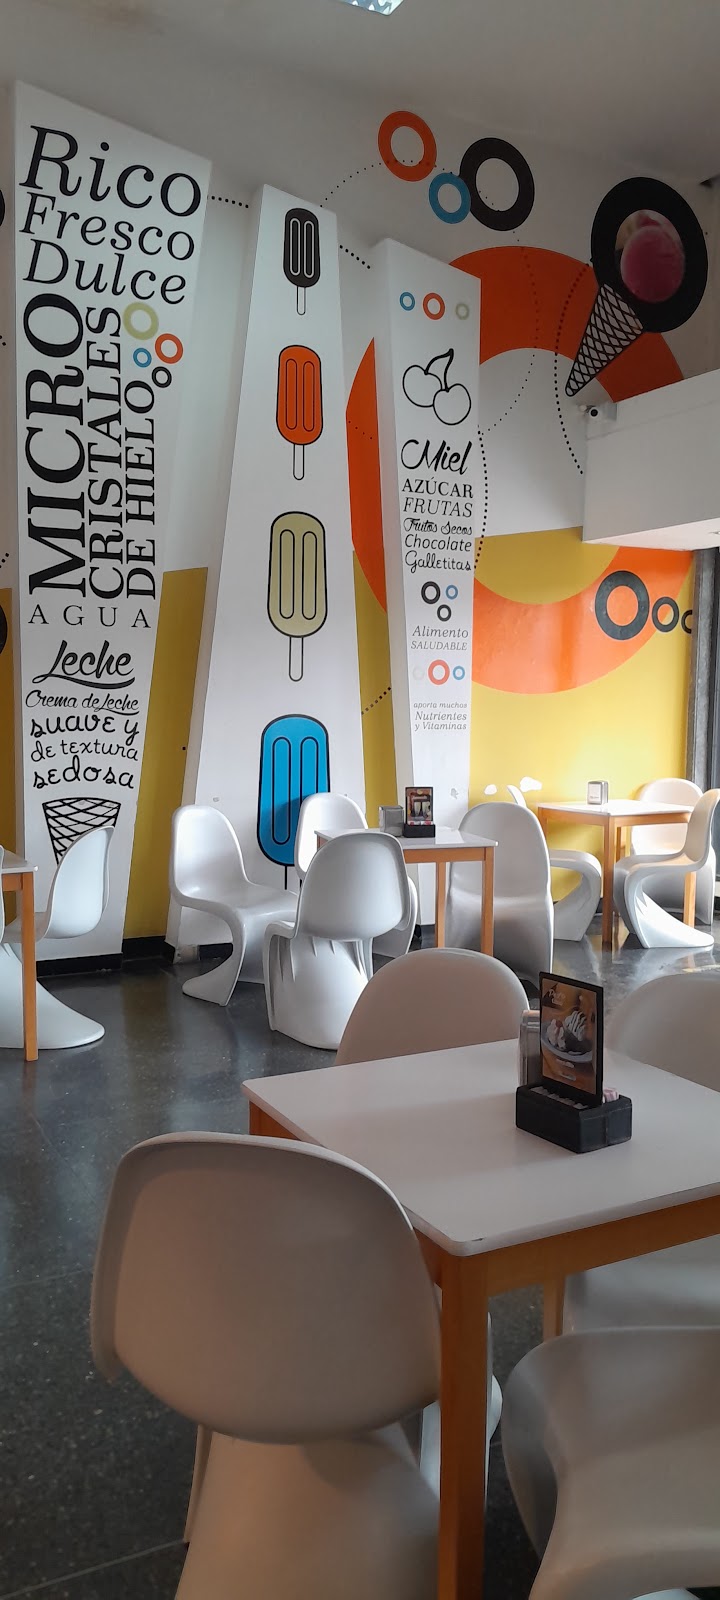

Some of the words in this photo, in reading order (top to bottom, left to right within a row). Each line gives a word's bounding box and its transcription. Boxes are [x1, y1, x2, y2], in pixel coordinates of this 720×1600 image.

[19, 125, 201, 217] Rico
[19, 192, 195, 260] Fresco
[23, 239, 186, 304] Dulce
[23, 293, 86, 597] MICRO
[86, 307, 124, 599] CRISTALES
[124, 380, 155, 525] HIELO
[401, 439, 472, 475] Miel
[402, 476, 473, 499] AZÚCAR
[403, 497, 473, 518] FRUTAS
[403, 517, 438, 532] Frutos
[441, 521, 472, 535] Secos
[405, 534, 472, 552] Chocolate
[126, 539, 155, 600] DE
[405, 550, 471, 573] Galletitas
[28, 604, 151, 628] AGUA
[412, 626, 469, 638] Alimento
[411, 641, 467, 651] SALUDABLE
[32, 640, 135, 689] Leche
[25, 690, 78, 709] Crema
[81, 693, 100, 710] de
[98, 693, 139, 715] Leche
[413, 702, 437, 710] aporta
[439, 701, 468, 709] muchos
[415, 711, 467, 721] Nutrientes
[422, 722, 467, 730] Vitaminas
[30, 713, 116, 738] suave
[124, 718, 139, 745] y
[31, 741, 56, 762] de
[60, 739, 138, 761] textura
[33, 755, 134, 789] sedosa
